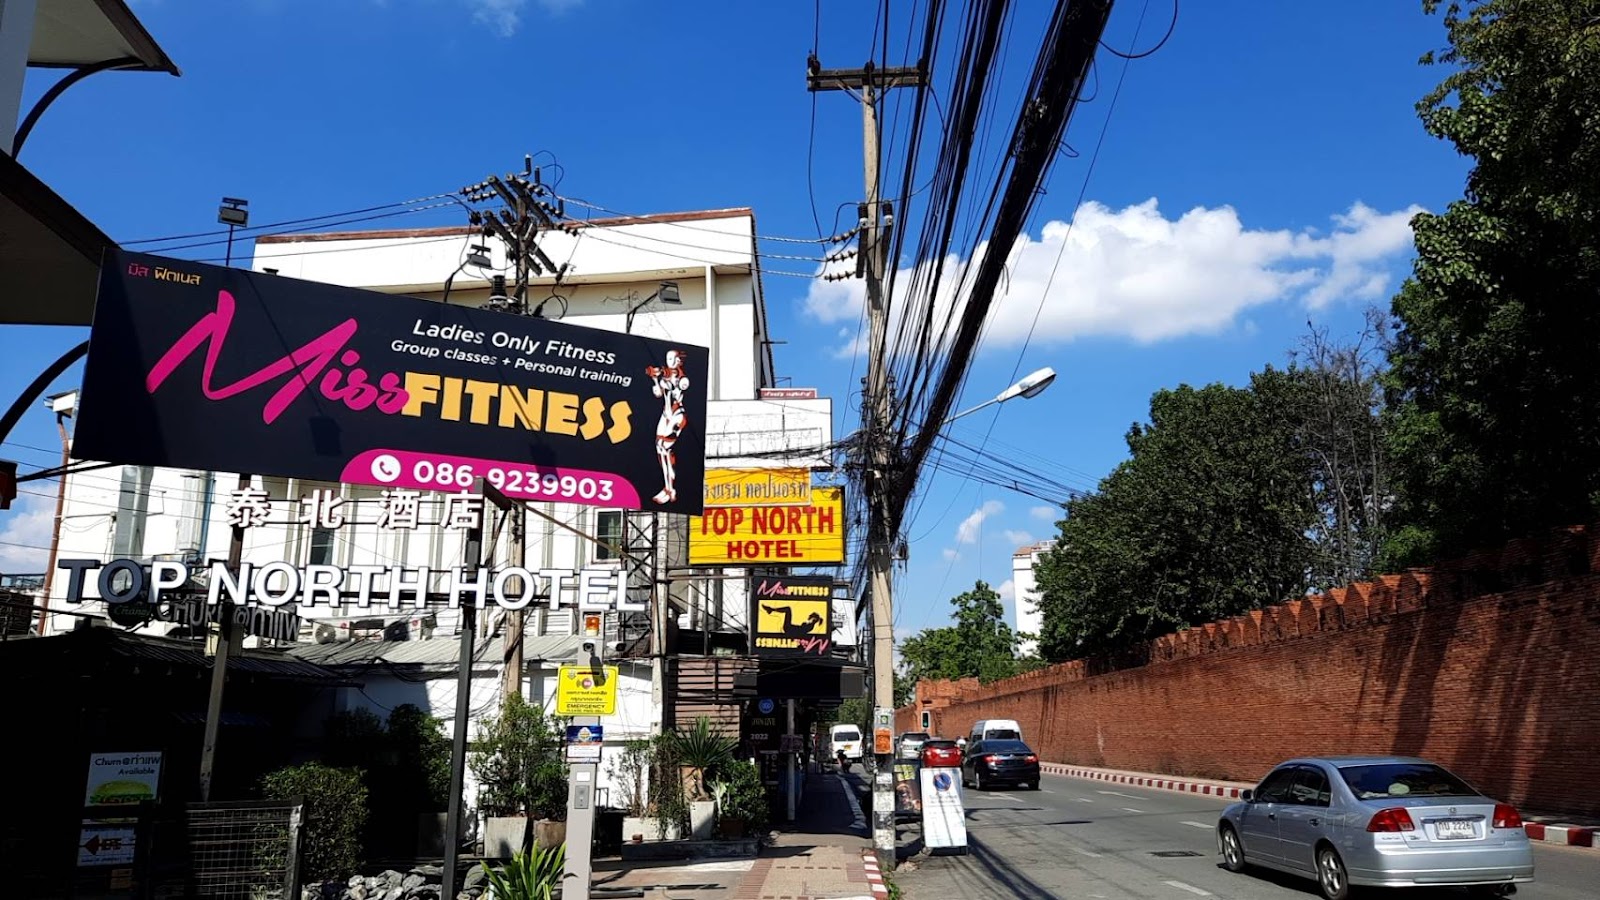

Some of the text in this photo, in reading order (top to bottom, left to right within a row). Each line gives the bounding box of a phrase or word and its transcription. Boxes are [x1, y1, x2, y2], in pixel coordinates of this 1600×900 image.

[154, 266, 202, 286] ฟิตเนส
[413, 318, 616, 365] Ladies Only Fitness
[146, 290, 633, 444] Miss FITNESS
[391, 339, 632, 388] Group classes + Personal training
[226, 487, 484, 530] 泰北酒店
[701, 506, 834, 536] TOP NORTH
[726, 540, 803, 559] HOTEL
[58, 558, 646, 613] TOP NORTH HOTEL
[118, 767, 155, 775] Available
